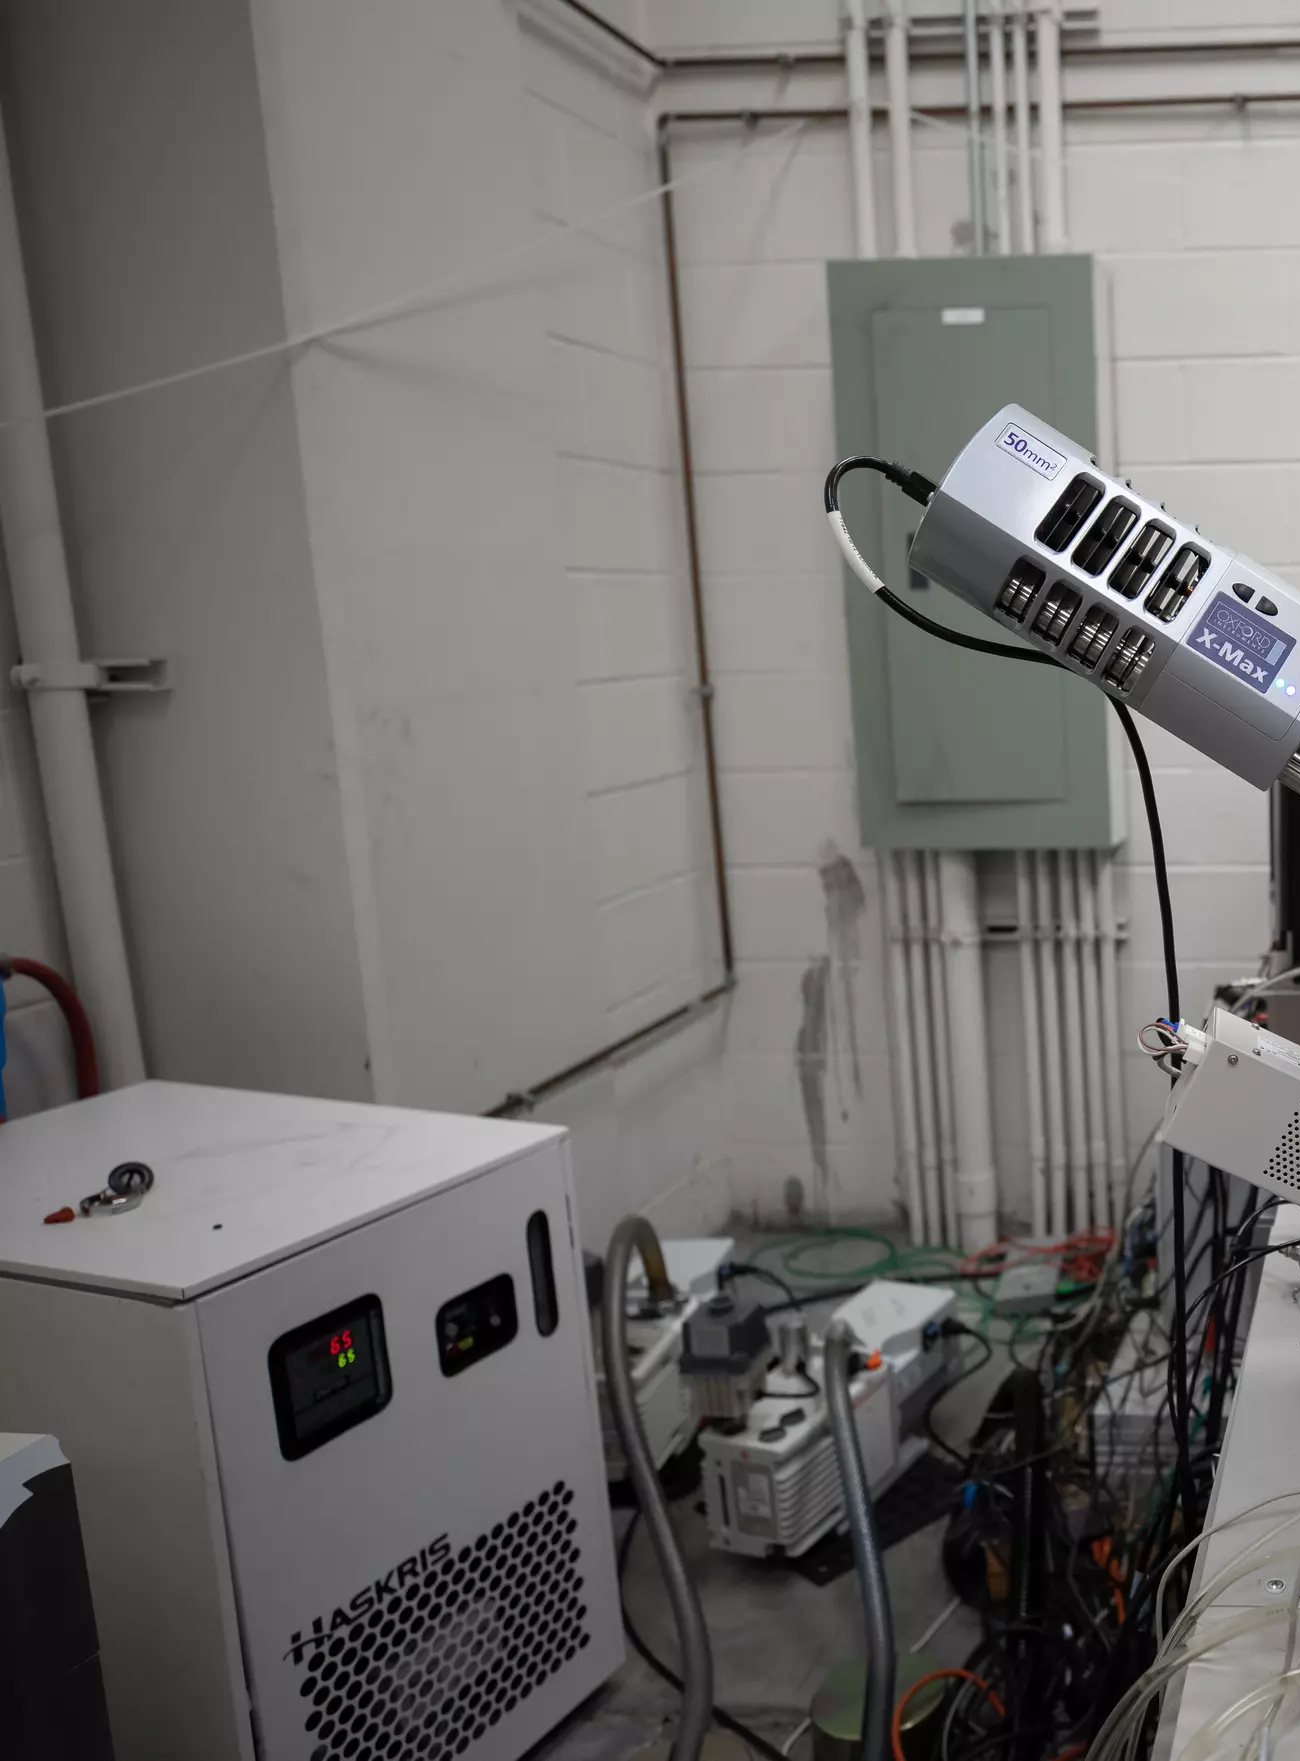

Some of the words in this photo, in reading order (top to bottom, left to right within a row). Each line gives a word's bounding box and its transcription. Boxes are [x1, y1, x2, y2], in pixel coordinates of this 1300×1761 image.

[1213, 618, 1265, 654] INSTRUMENTS
[1216, 609, 1271, 649] OXFORD
[1195, 627, 1269, 684] X-Max
[330, 1329, 352, 1355] 65
[338, 1348, 356, 1368] 65
[282, 1532, 451, 1667] HASKRIS
